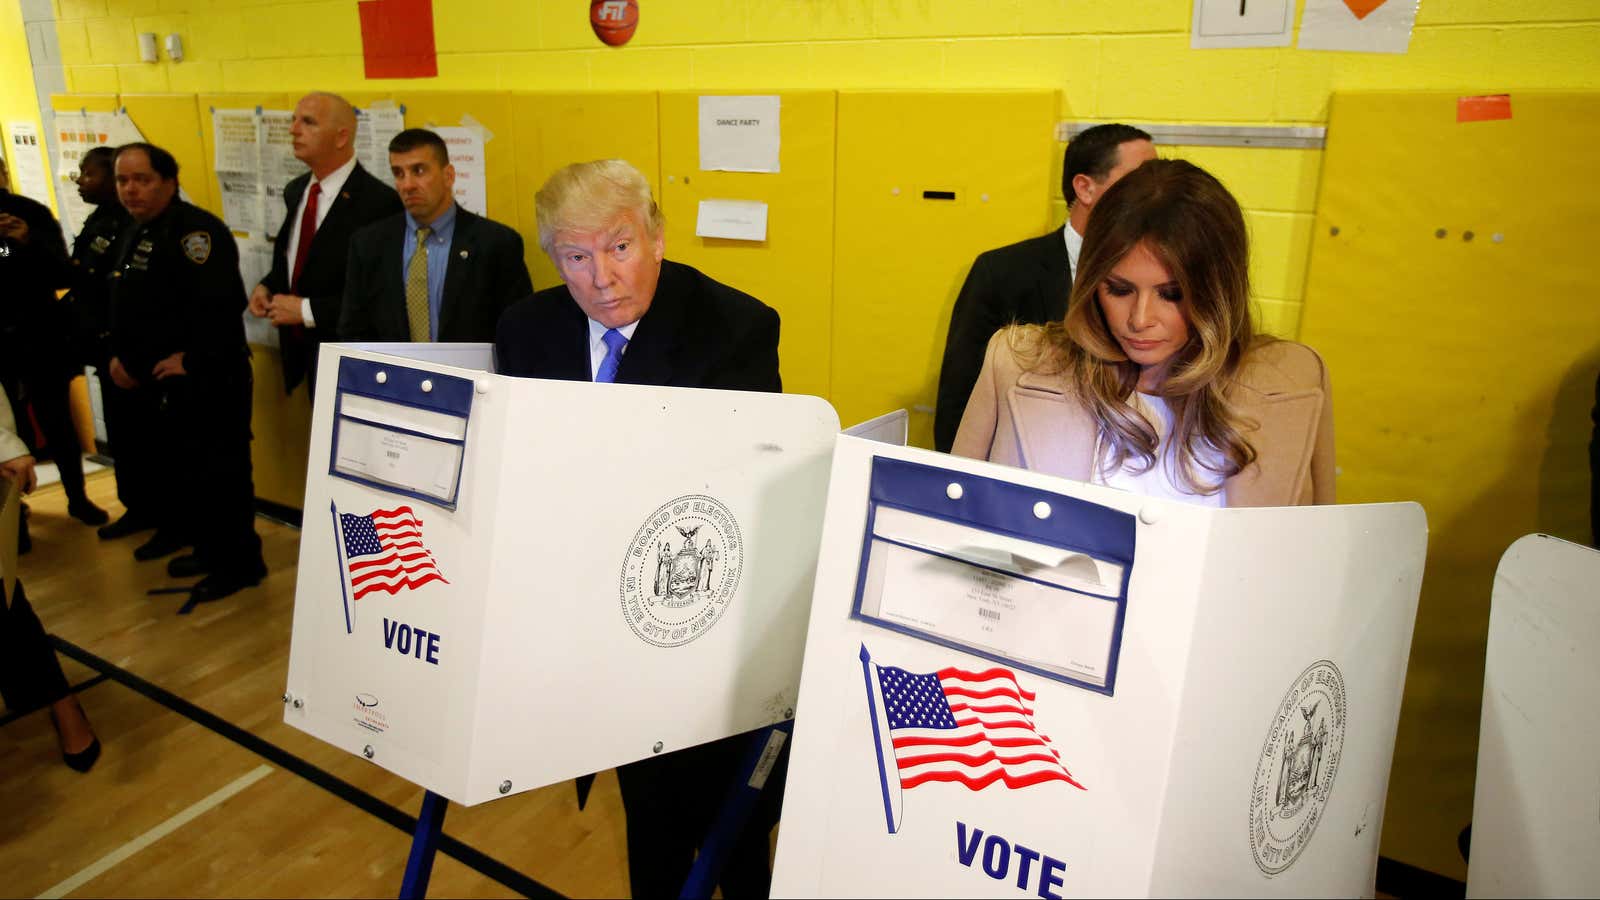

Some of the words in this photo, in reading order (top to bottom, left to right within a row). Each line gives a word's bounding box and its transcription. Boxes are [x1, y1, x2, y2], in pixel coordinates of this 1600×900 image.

[633, 511, 670, 558] BOARD
[672, 502, 689, 516] OF
[692, 502, 737, 551] ELECTIONS
[626, 576, 636, 593] IN
[716, 567, 737, 606] YORK
[628, 595, 645, 624] THE
[690, 607, 715, 634] NEW
[383, 617, 441, 665] VOTE
[642, 621, 670, 640] CITY
[671, 627, 688, 640] OF
[1265, 690, 1299, 757] BOARD
[1301, 672, 1314, 693] OF
[956, 820, 1067, 899] VOTE
[1262, 842, 1282, 864] CITY
